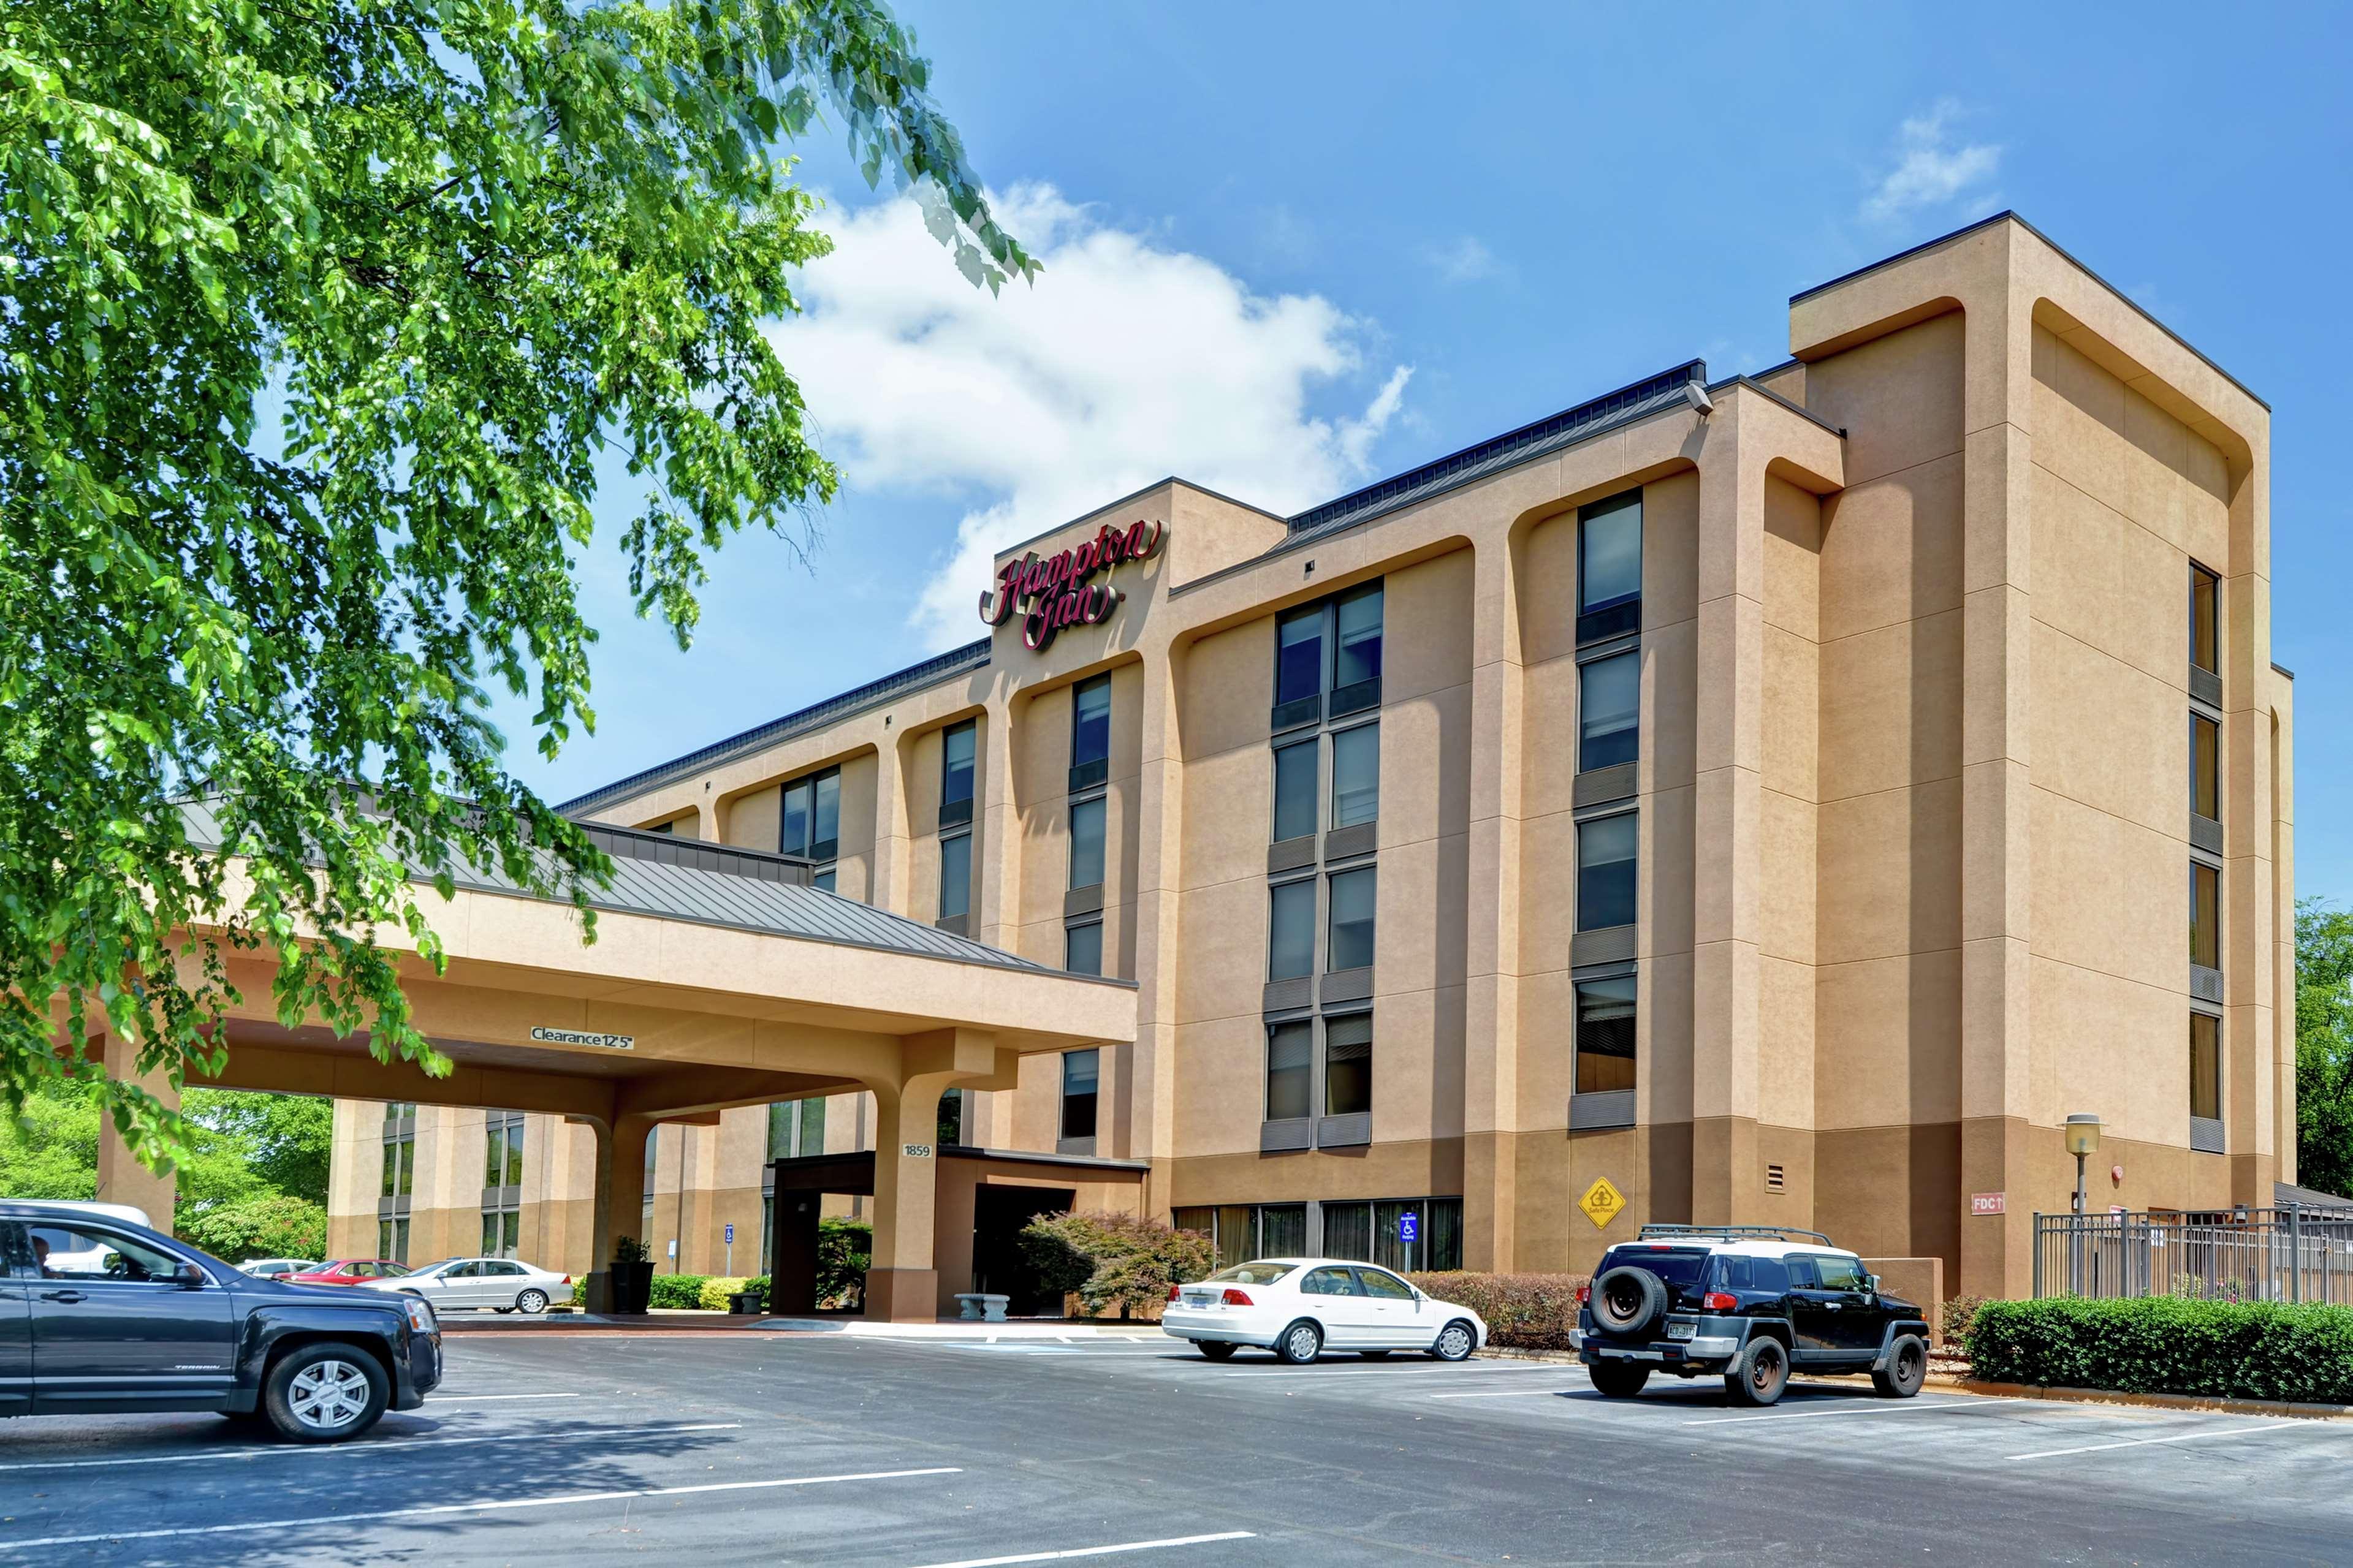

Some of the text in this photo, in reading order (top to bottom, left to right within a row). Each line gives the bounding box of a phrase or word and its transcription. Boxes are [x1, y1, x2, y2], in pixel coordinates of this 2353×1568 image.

[979, 520, 1168, 626] Hampton
[1022, 584, 1116, 650] Inn
[532, 1028, 601, 1045] Clearance
[905, 1145, 930, 1157] 1859
[1974, 1198, 1996, 1210] FDC
